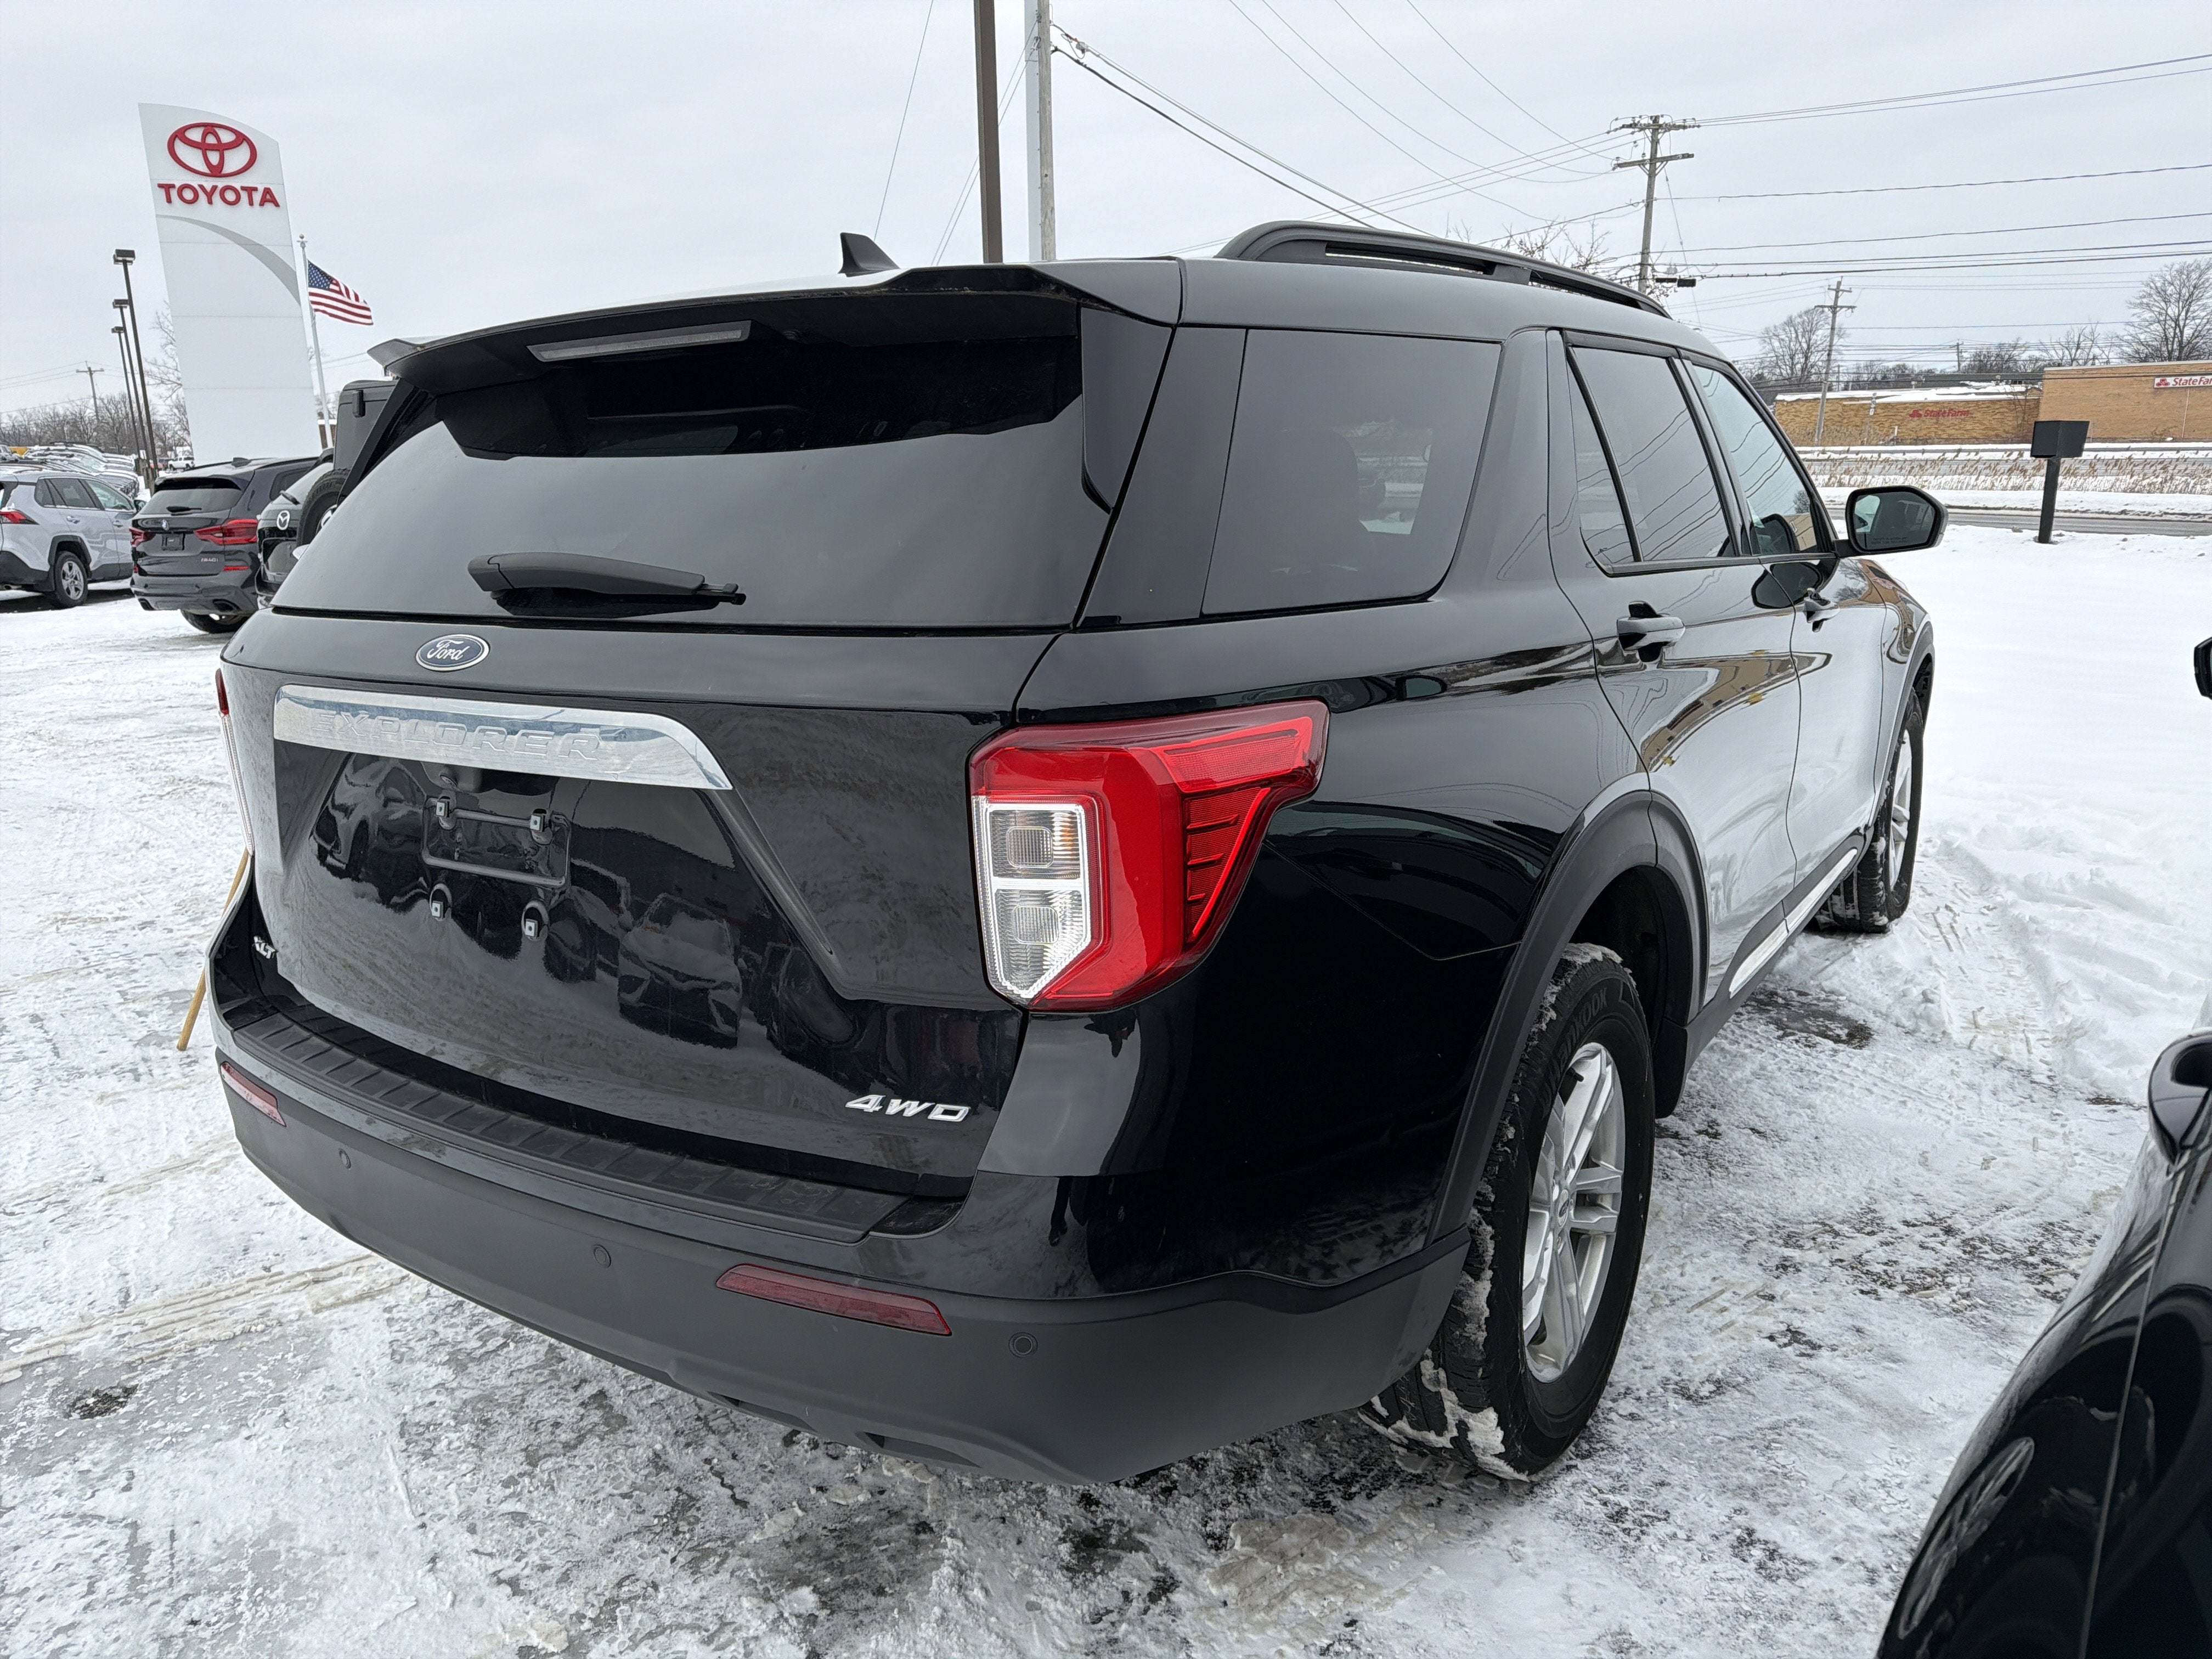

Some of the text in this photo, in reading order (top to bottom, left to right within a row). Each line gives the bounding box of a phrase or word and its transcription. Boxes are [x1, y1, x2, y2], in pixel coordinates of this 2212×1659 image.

[157, 183, 280, 207] TOYOTA
[427, 639, 470, 661] Ford
[312, 710, 601, 761] EXPLORER
[253, 935, 276, 959] XLT
[845, 1094, 971, 1122] 4WD
